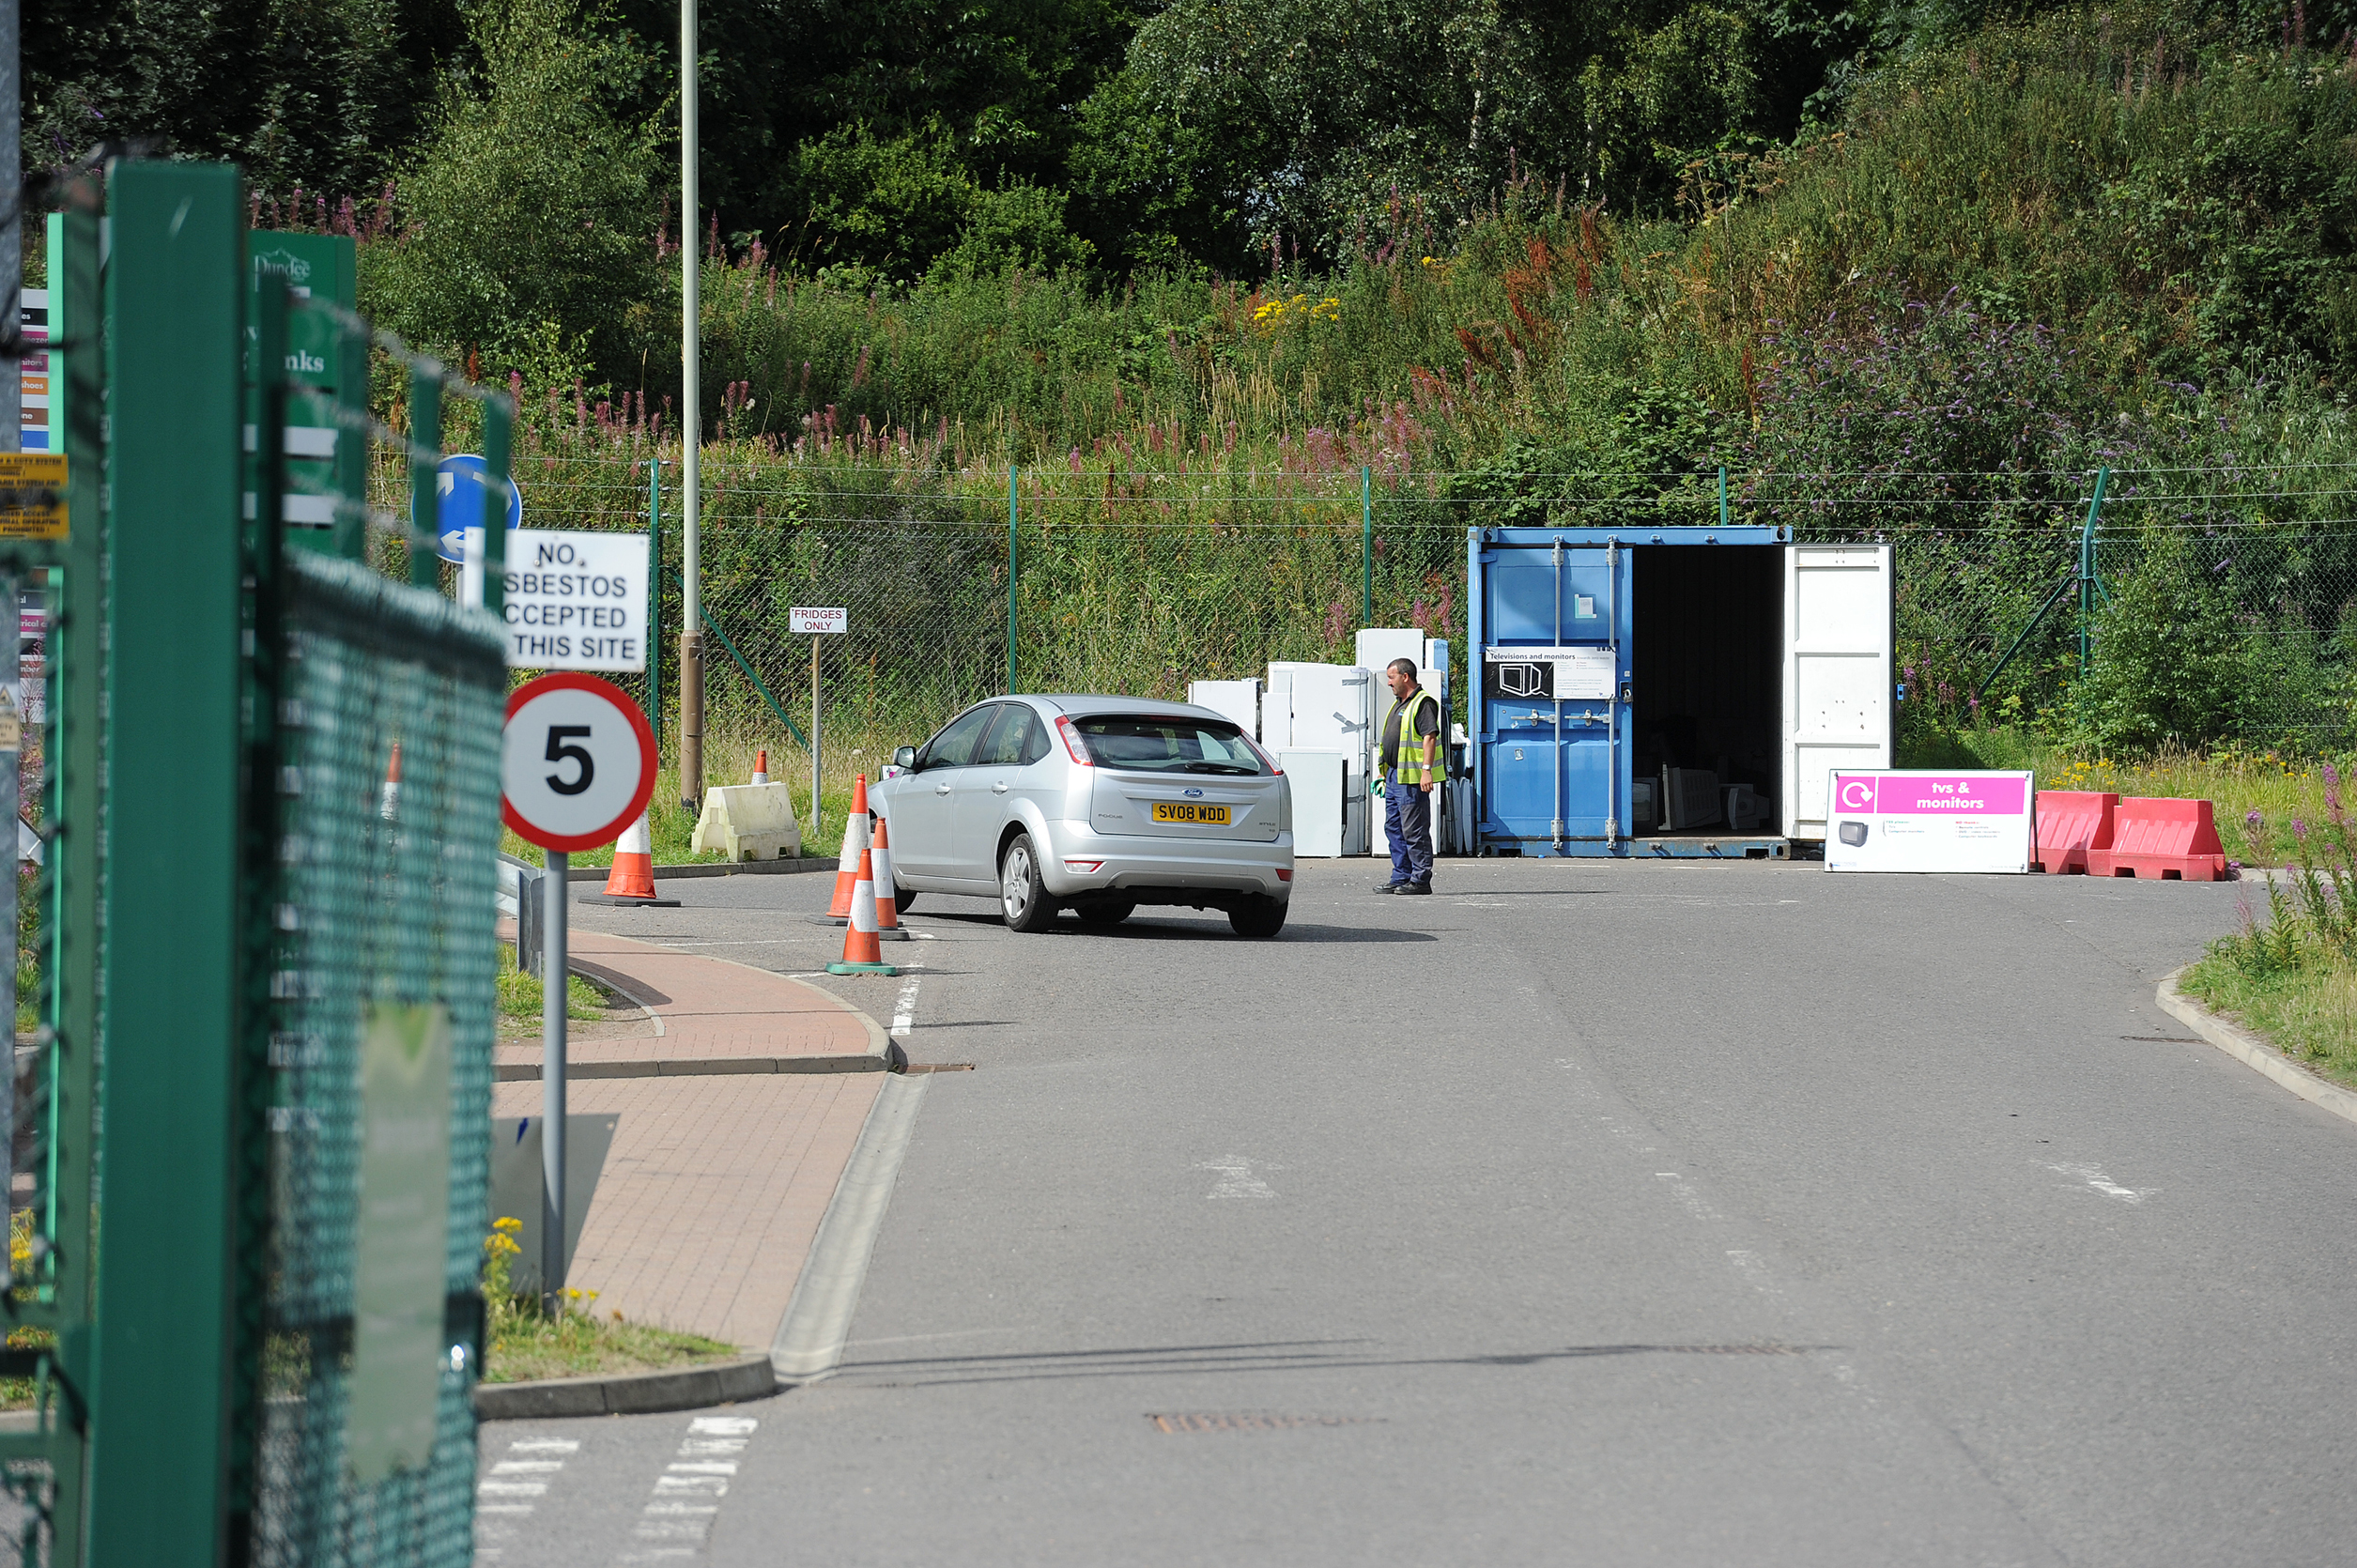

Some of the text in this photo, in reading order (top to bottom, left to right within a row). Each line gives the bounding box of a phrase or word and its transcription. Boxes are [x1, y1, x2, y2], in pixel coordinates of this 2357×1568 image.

[538, 543, 575, 564] NO
[503, 573, 626, 598] SBESTOS
[503, 604, 626, 628] CCEPTED
[794, 609, 842, 619] FRIDGES
[804, 621, 832, 630] ONLY
[514, 635, 637, 659] THIS SITE
[545, 725, 595, 796] 5
[1932, 781, 1970, 794] tvs &
[1916, 796, 1984, 809] monitors
[1159, 805, 1225, 821] SV08 WDD
